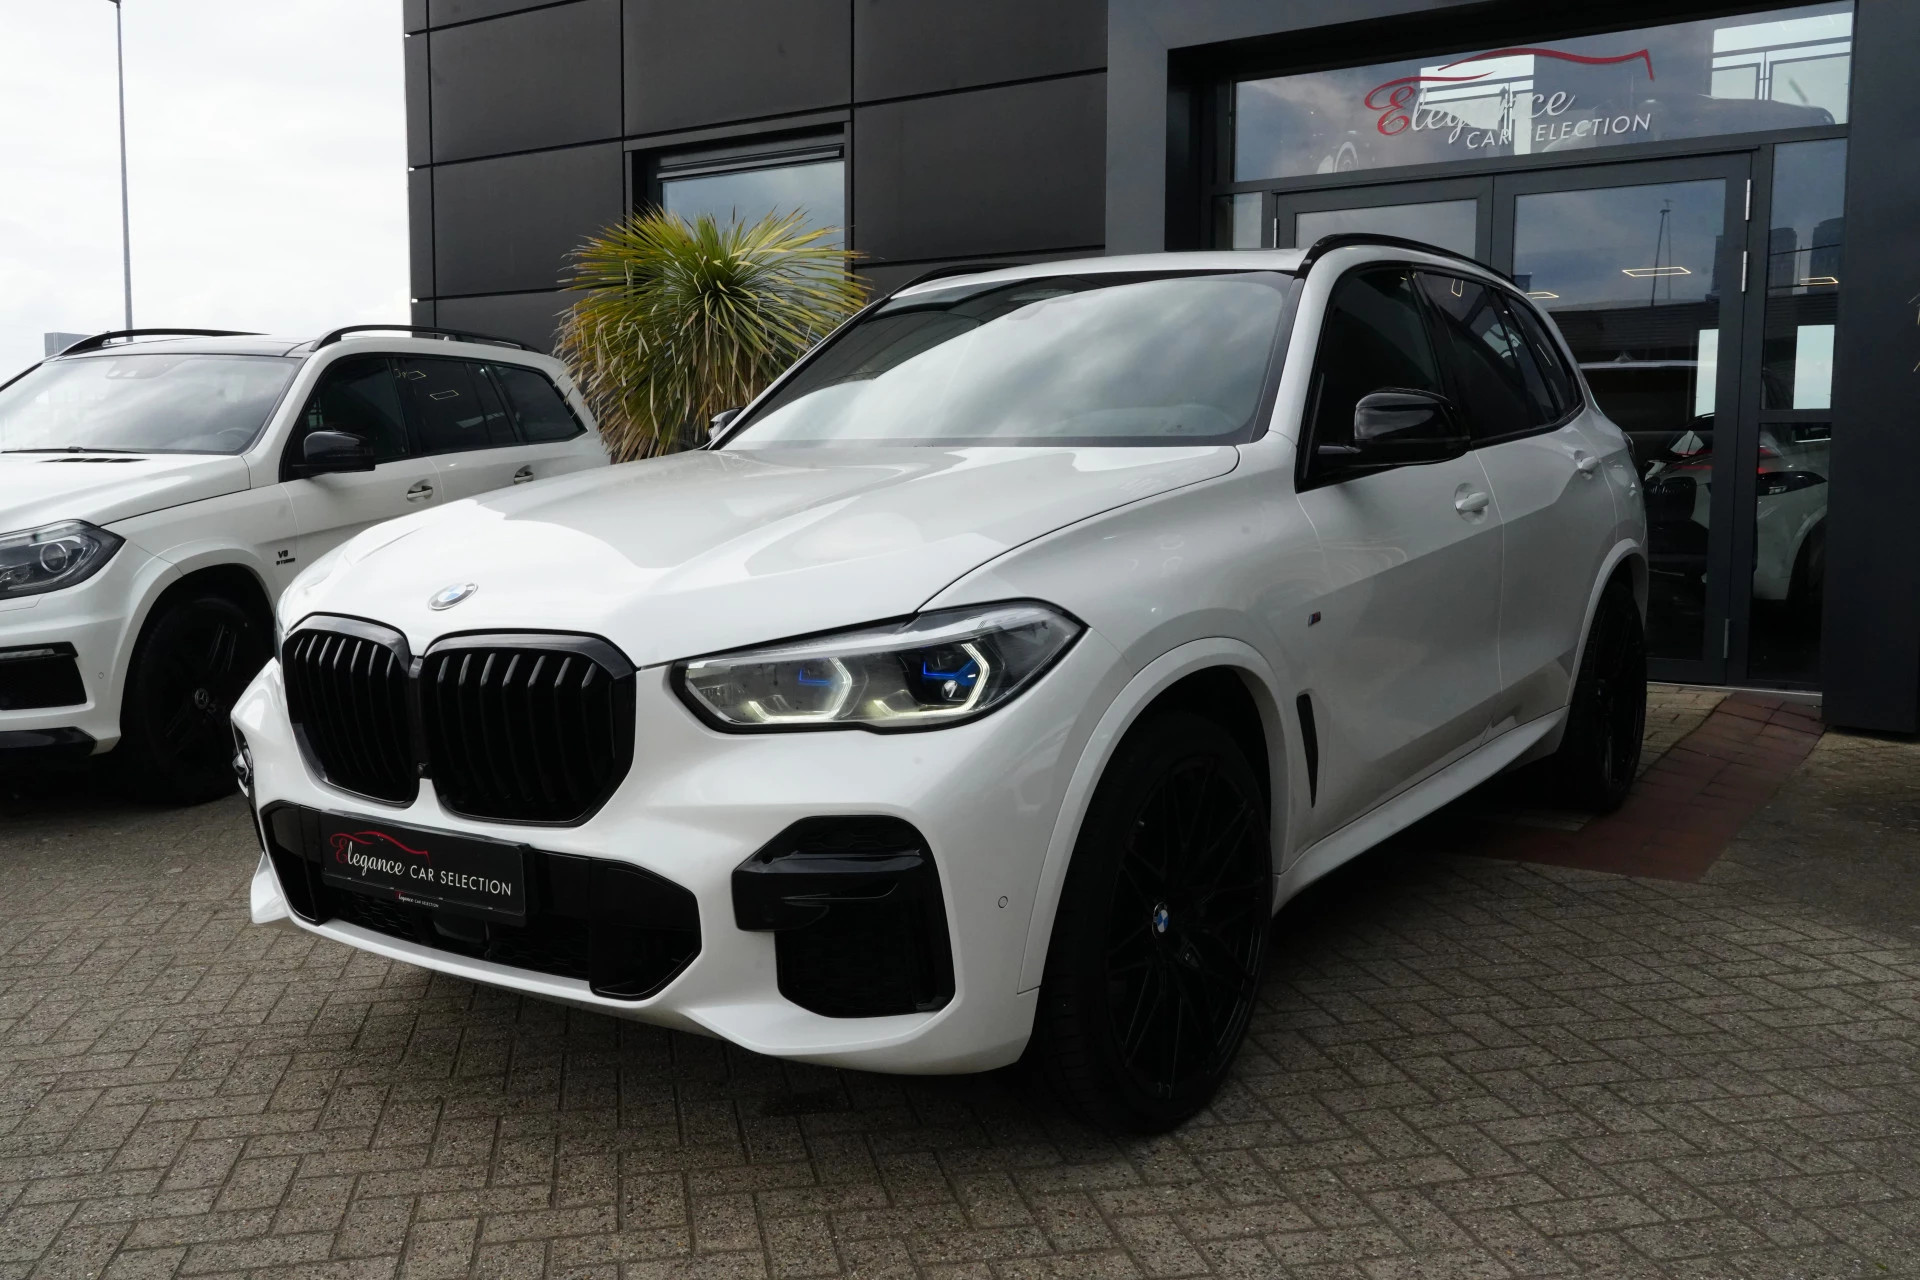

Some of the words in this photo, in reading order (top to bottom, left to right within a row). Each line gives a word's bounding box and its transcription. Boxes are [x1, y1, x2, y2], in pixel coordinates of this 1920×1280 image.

[1364, 76, 1576, 145] Elegnce
[1466, 129, 1511, 149] CAR
[1519, 113, 1651, 142] ELECTION
[330, 833, 406, 877] Elegance
[410, 865, 434, 882] CAR
[440, 870, 512, 897] SELECTION
